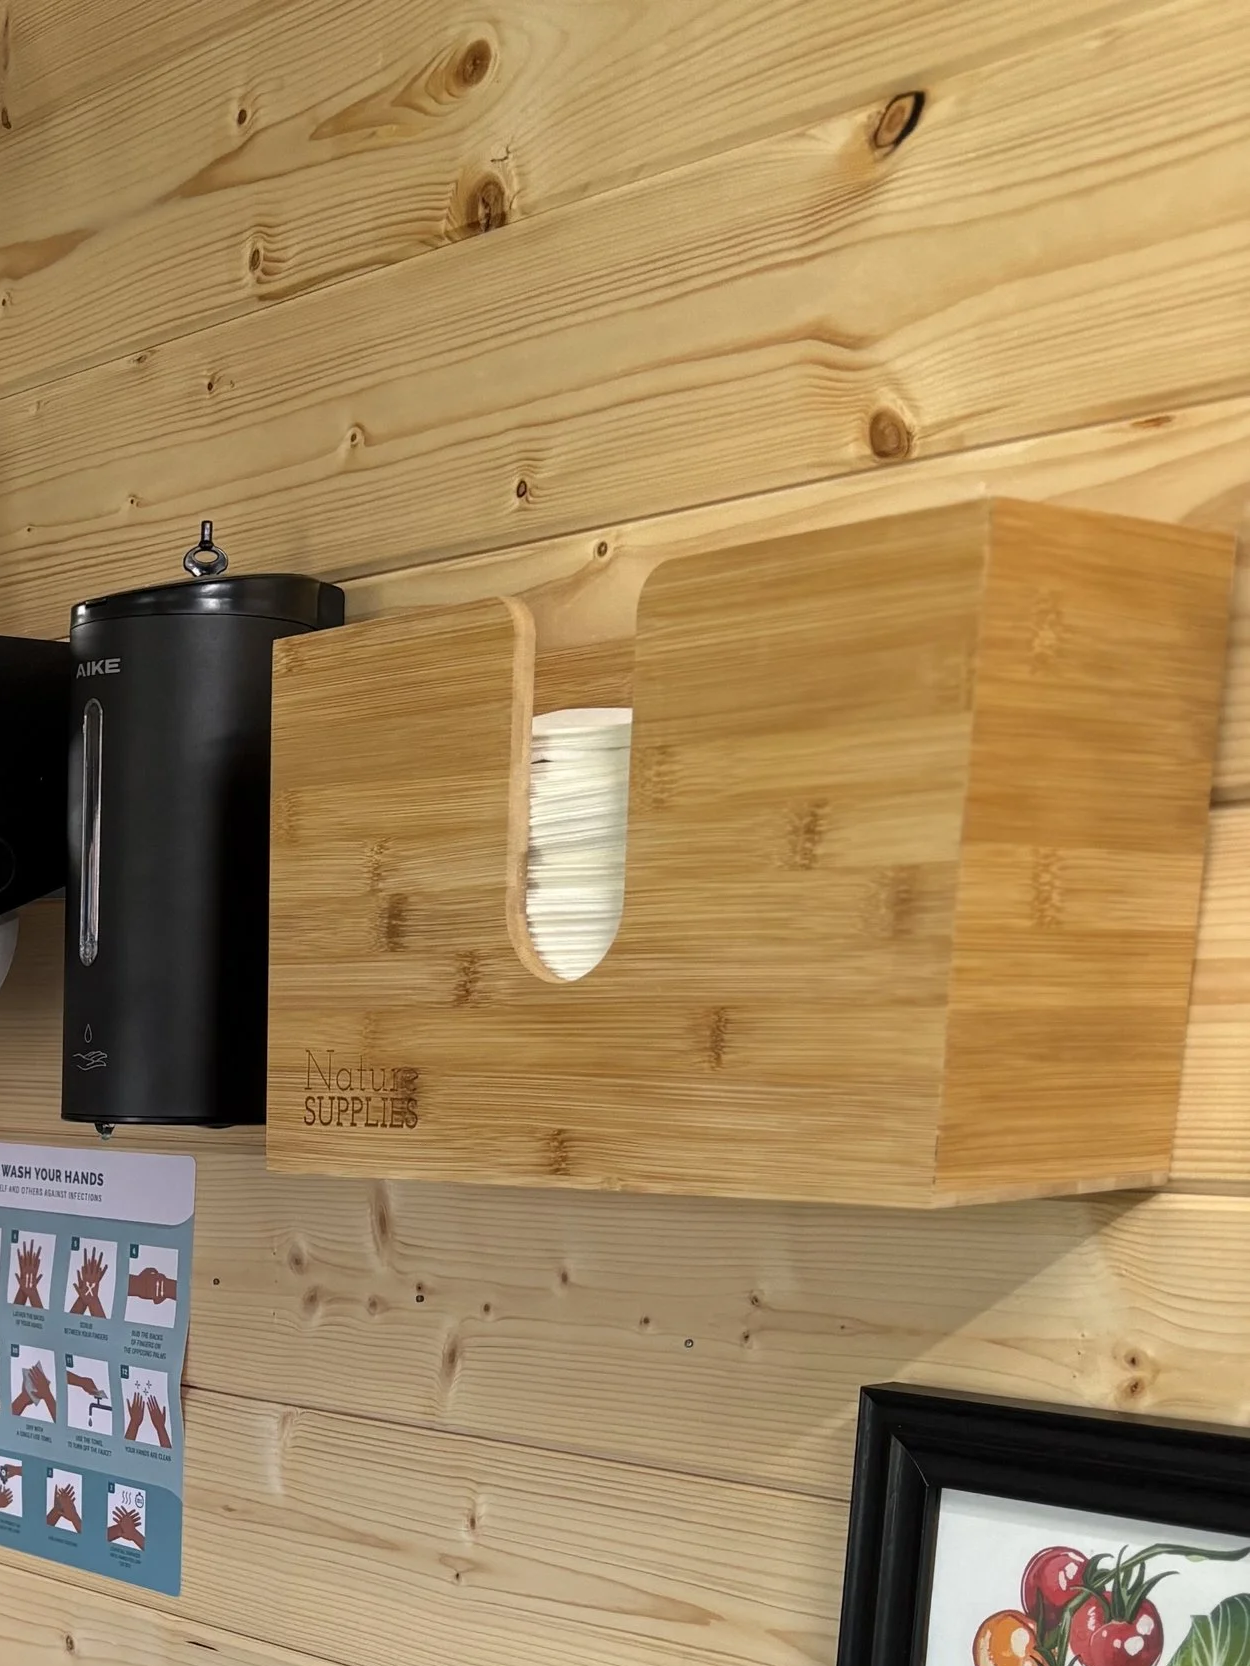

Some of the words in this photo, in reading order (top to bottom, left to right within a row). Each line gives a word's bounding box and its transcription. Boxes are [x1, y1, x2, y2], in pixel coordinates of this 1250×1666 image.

[76, 658, 121, 679] AIKE
[304, 1050, 419, 1092] Nature
[304, 1096, 419, 1130] SUPPLIES
[2, 1164, 32, 1180] WASH
[34, 1167, 62, 1183] YOUR
[64, 1170, 104, 1186] HANDS
[9, 1185, 20, 1194] AND
[21, 1187, 43, 1197] OTHERS
[44, 1189, 67, 1199] AGAINST
[68, 1191, 103, 1202] INFECTIONS
